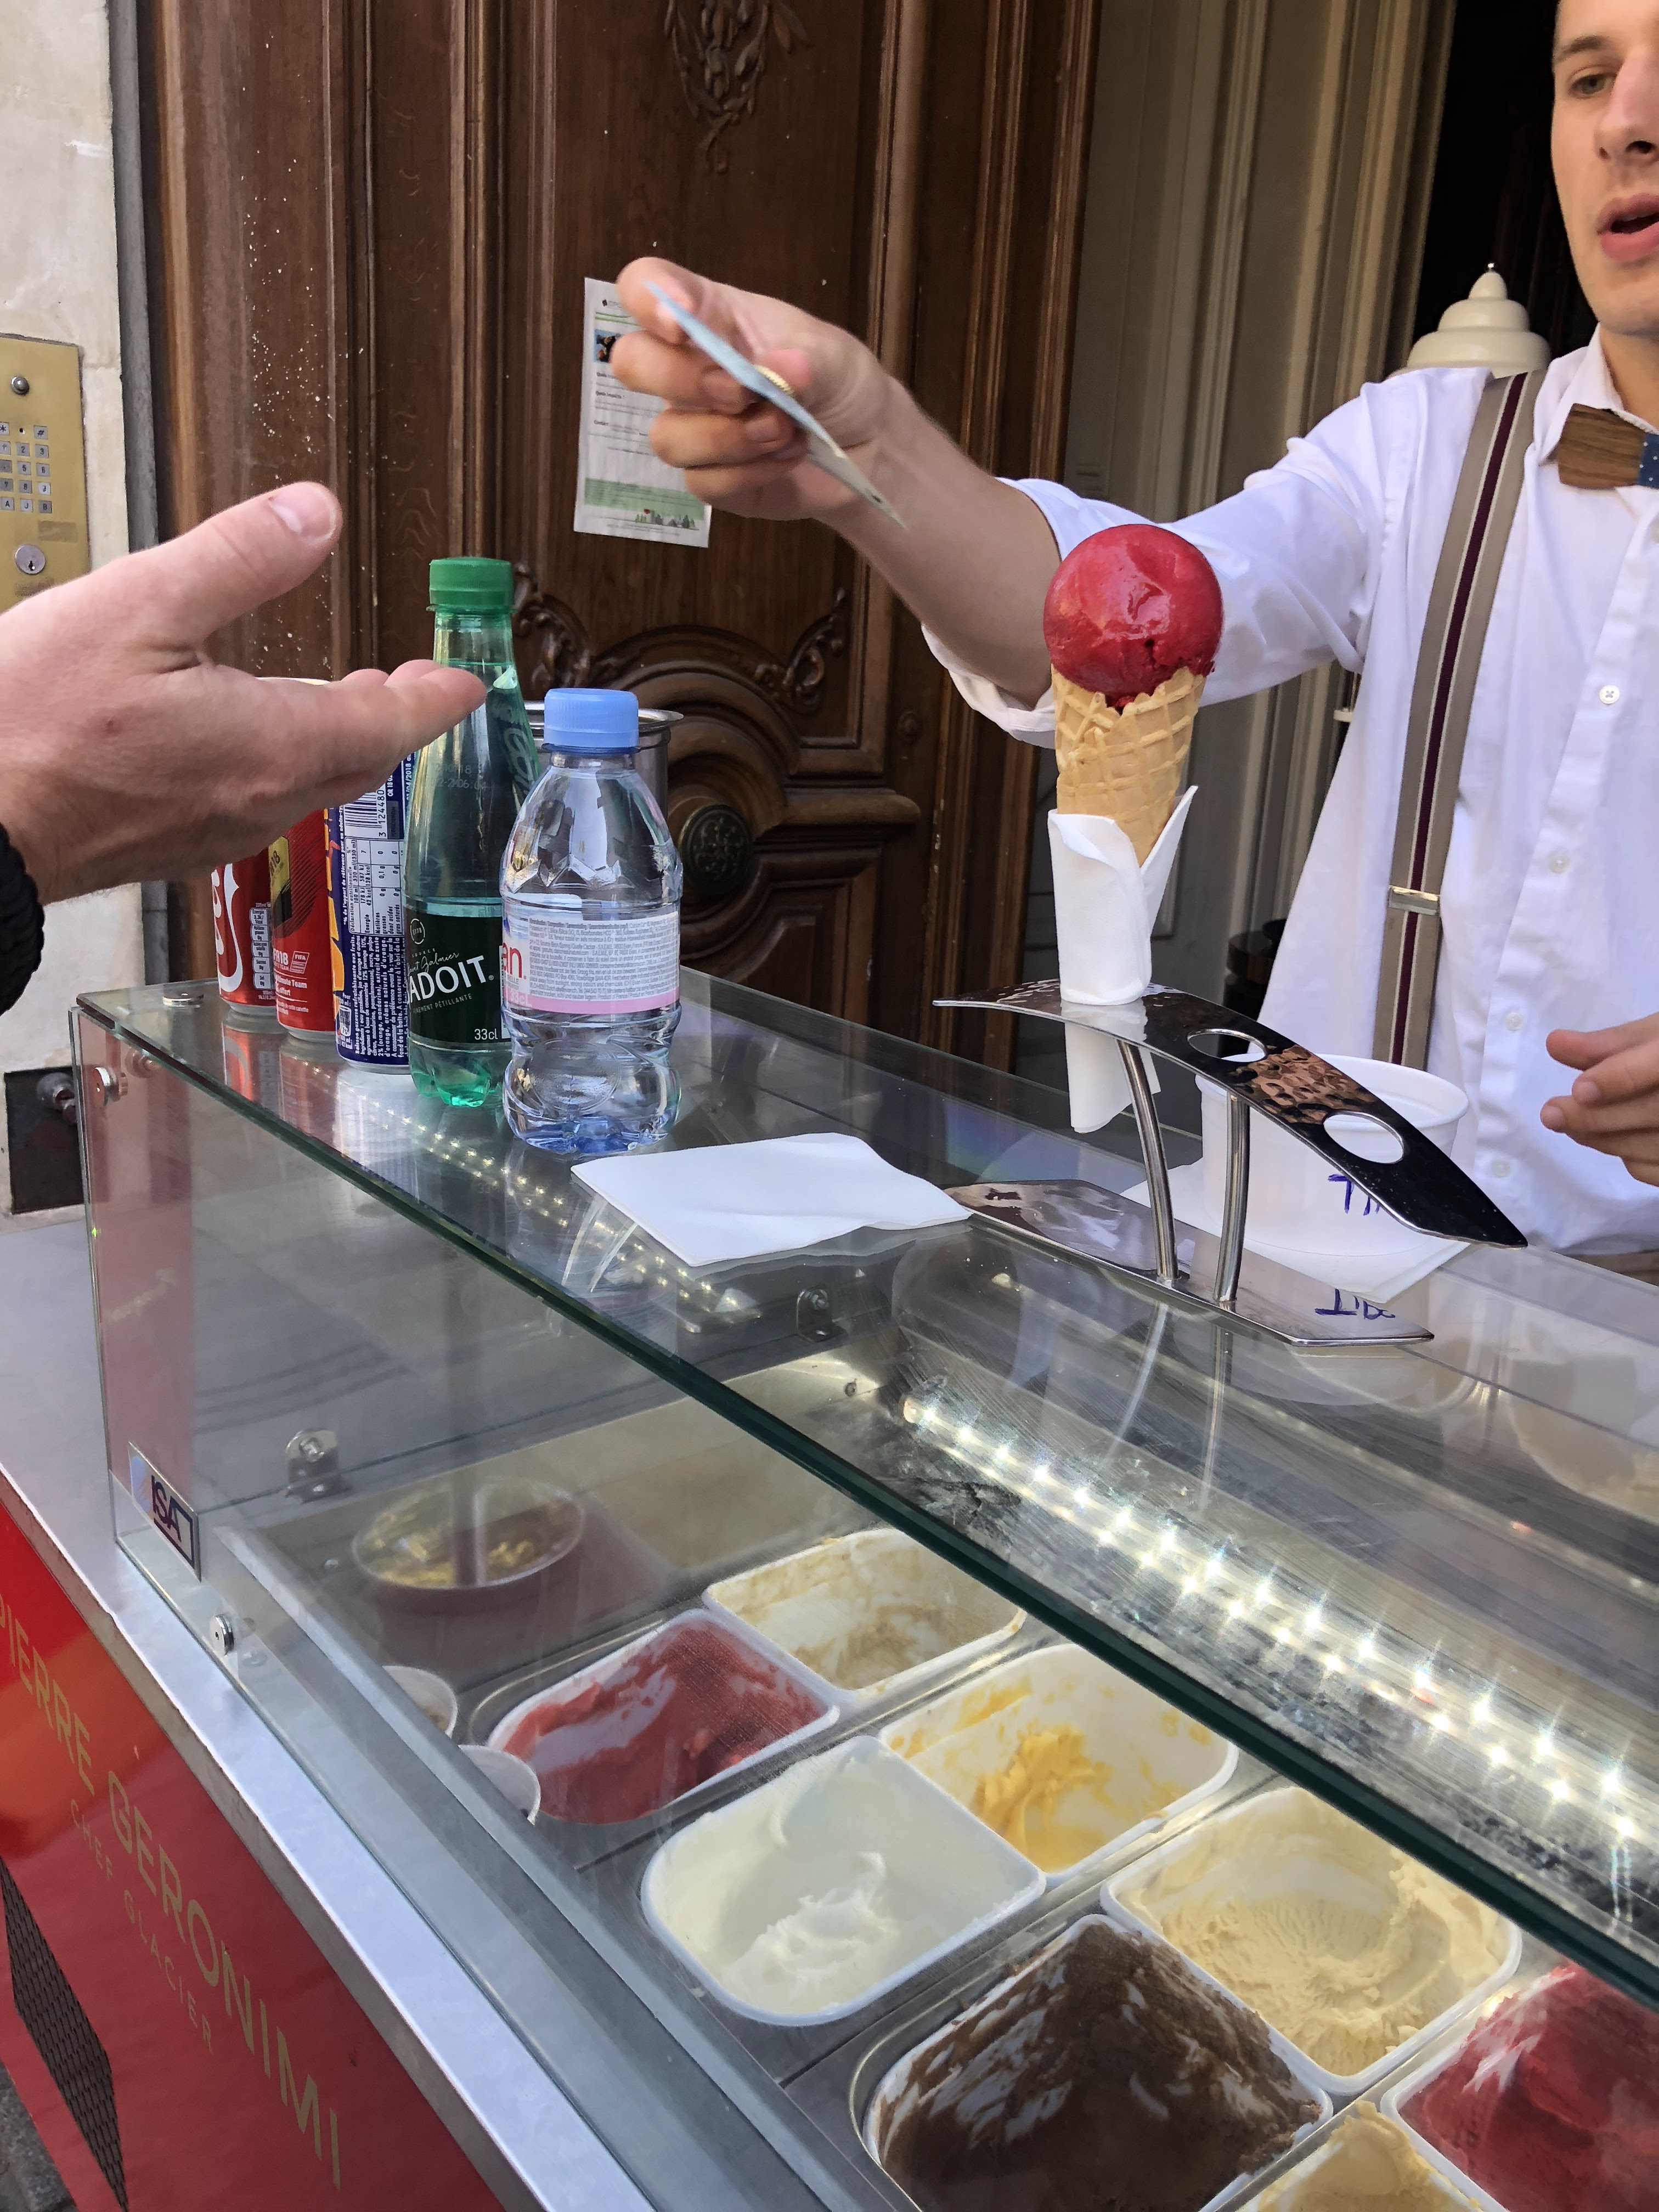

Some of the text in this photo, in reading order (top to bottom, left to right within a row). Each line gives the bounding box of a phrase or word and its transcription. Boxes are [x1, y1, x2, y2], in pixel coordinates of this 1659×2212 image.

[377, 789, 385, 824] 124480
[292, 979, 307, 989] Team
[407, 955, 486, 1004] ADOIT
[474, 1028, 498, 1040] 33cl
[378, 1048, 383, 1056] 2%
[71, 1799, 213, 2055] CHEF GLACIER
[108, 1770, 341, 2191] GERONIMI
